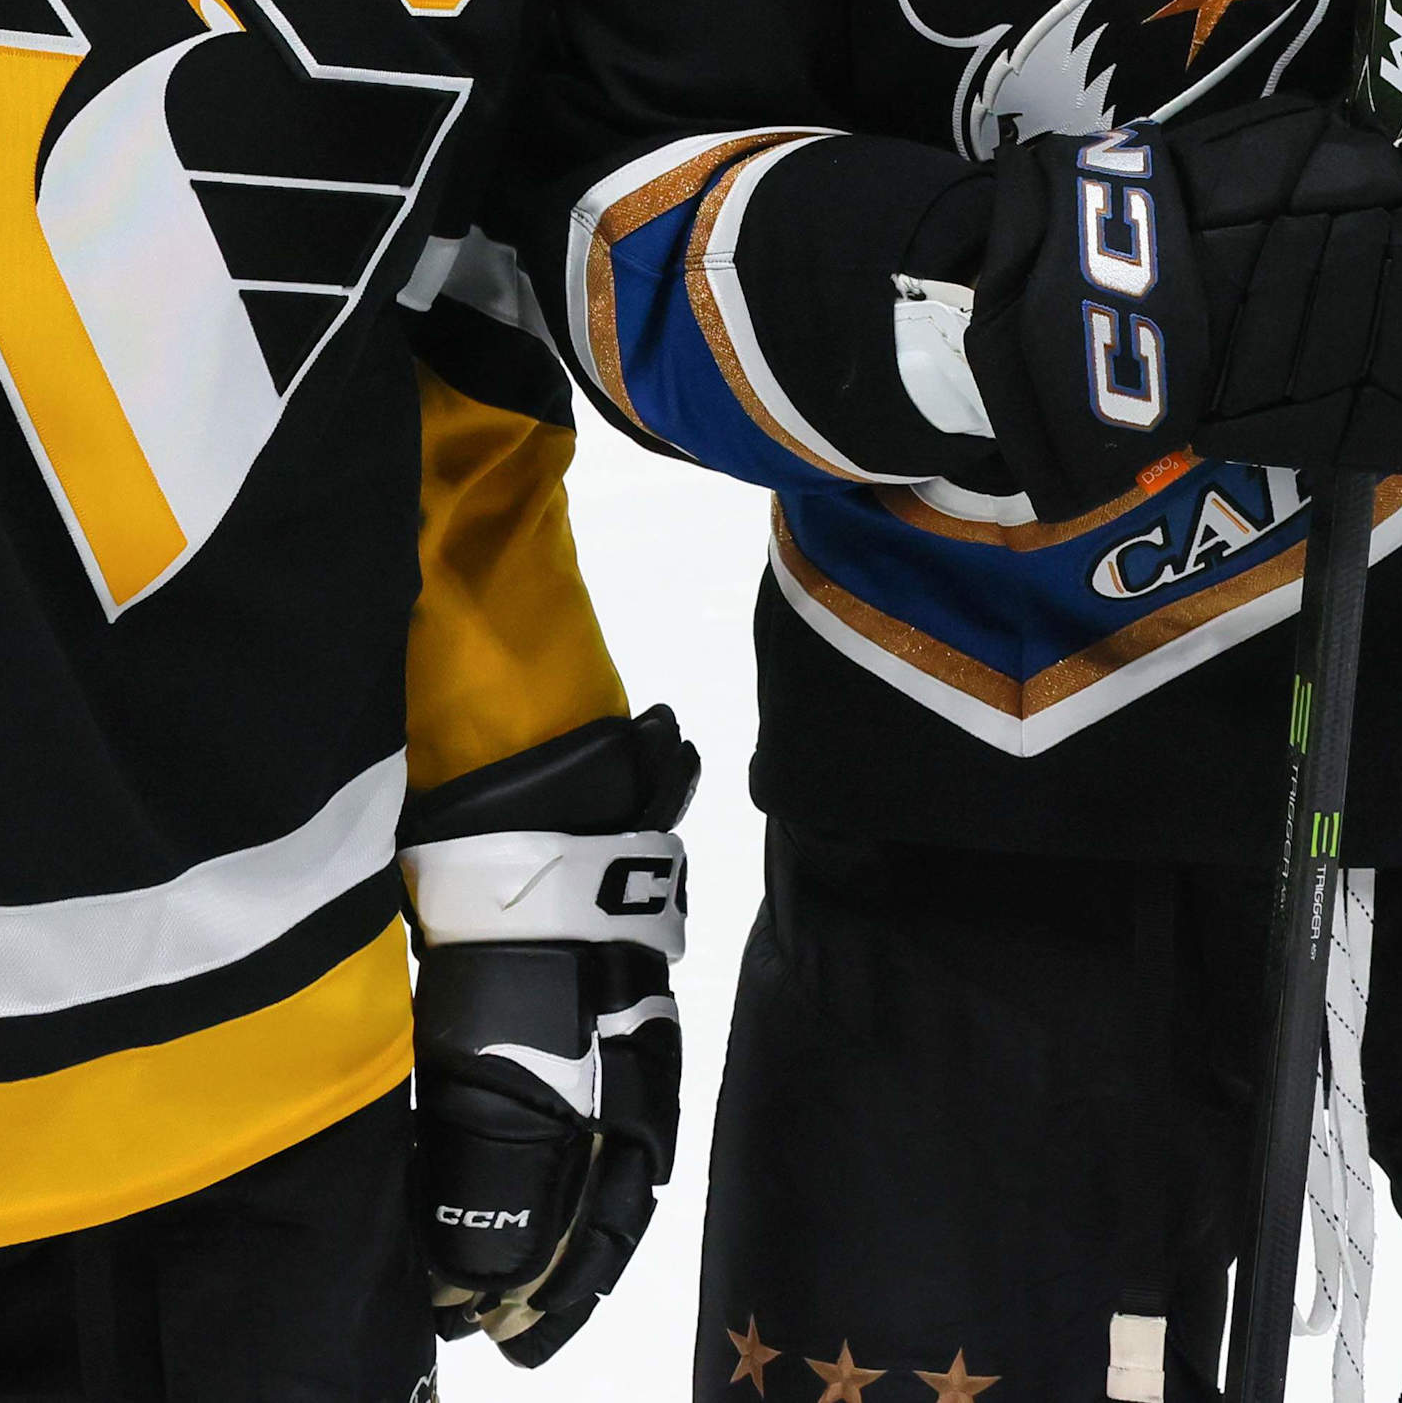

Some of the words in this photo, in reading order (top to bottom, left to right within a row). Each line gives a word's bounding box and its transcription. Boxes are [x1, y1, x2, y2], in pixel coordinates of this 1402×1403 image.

[1281, 763, 1300, 879] TRIGGER
[1310, 863, 1327, 940] TRIGGER
[436, 1204, 533, 1230] CCM
